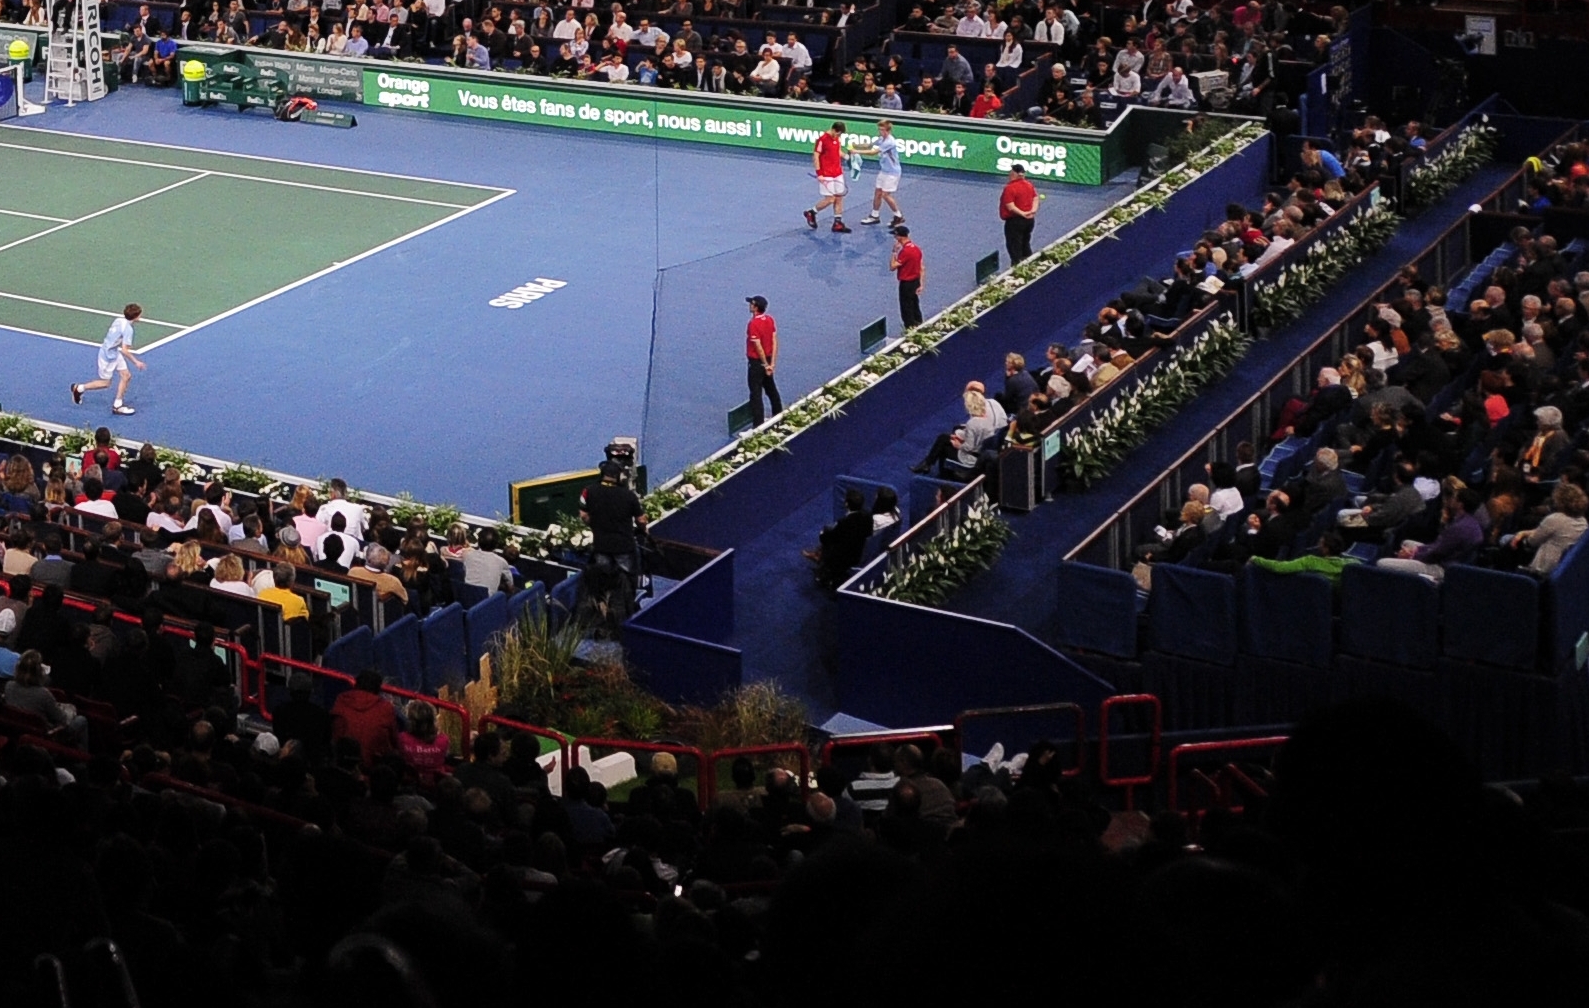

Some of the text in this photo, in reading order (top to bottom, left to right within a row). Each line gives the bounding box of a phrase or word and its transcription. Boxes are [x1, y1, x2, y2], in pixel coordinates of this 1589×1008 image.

[87, 4, 102, 84] RICOH
[223, 65, 239, 73] FedEx
[260, 68, 277, 77] FedEx
[296, 63, 315, 72] Miami
[319, 65, 358, 77] Monte-Carlo
[317, 86, 342, 96] Londres
[377, 73, 429, 93] Orange
[210, 92, 227, 100] FedEx
[247, 96, 264, 104] FedEx
[378, 90, 429, 108] sport
[457, 89, 762, 138] Vous êtes fans de sport, nous aussi !
[996, 136, 1067, 161] Orange
[996, 157, 1066, 177] sport
[488, 277, 568, 309] PARIS
